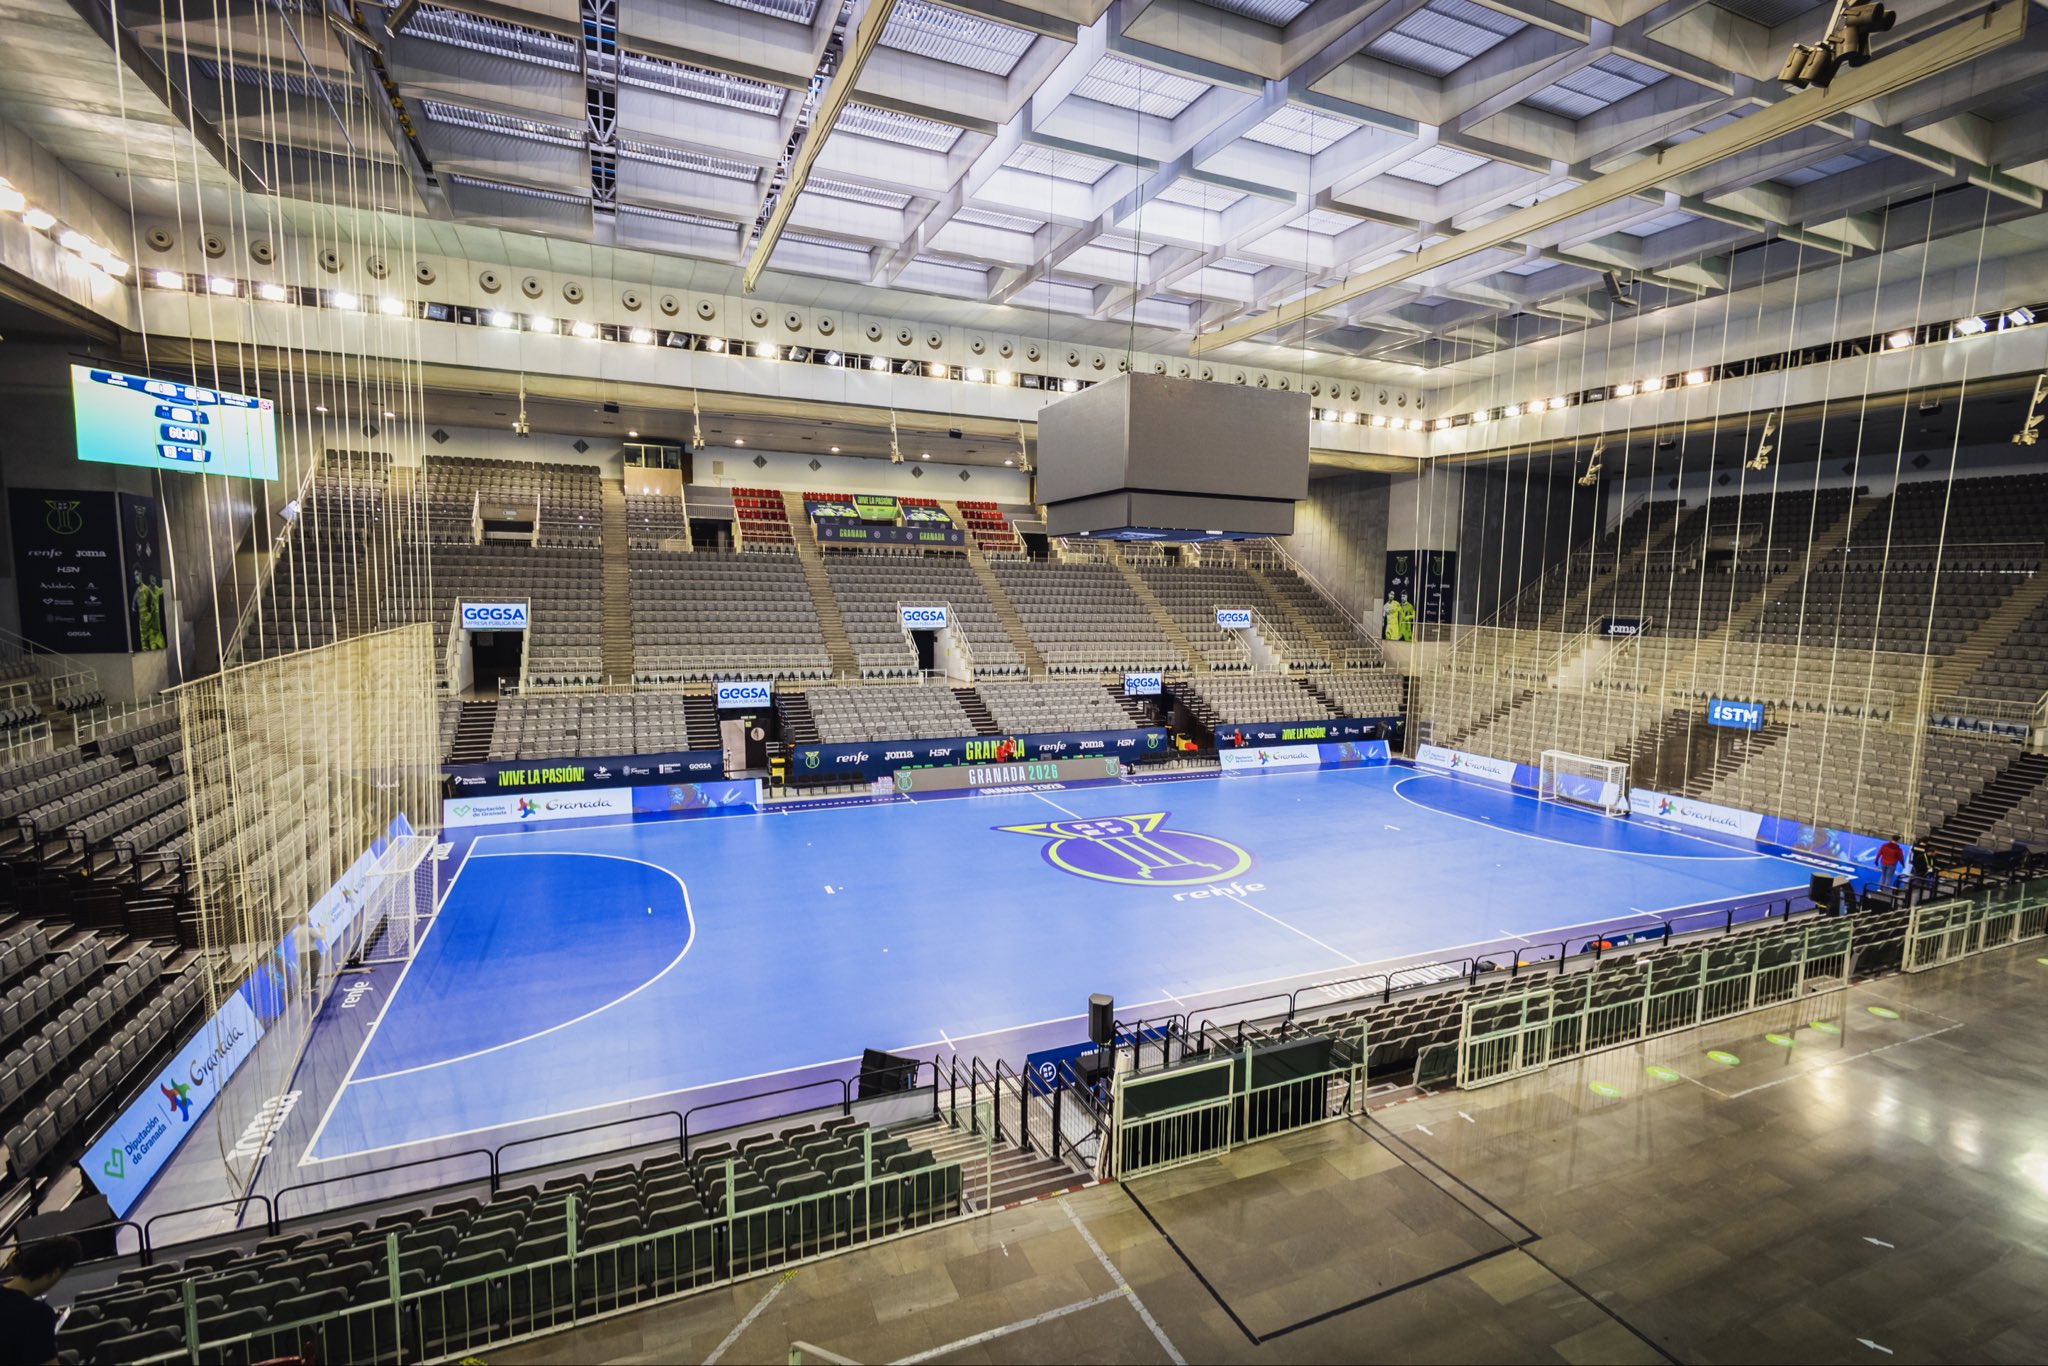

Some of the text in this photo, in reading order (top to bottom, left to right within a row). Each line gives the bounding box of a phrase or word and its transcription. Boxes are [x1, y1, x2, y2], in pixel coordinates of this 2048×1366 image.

[168, 426, 199, 441] 60:00
[839, 528, 867, 538] GRANADA
[919, 531, 945, 541] GRANADA
[28, 548, 63, 559] renfe
[1296, 728, 1304, 739] LA
[836, 751, 869, 765] renfe
[1039, 740, 1067, 753] renfe
[498, 765, 585, 787] ¡VIVE LA PASIÓN!
[968, 763, 1059, 785] GRANADA 2026
[545, 798, 613, 811] Granada
[1680, 805, 1739, 828] Granada
[1171, 880, 1267, 902] renfe
[341, 981, 374, 1008] renfe
[190, 1026, 245, 1087] Granada
[124, 1115, 160, 1156] Diputación
[131, 1124, 168, 1165] de Granada
